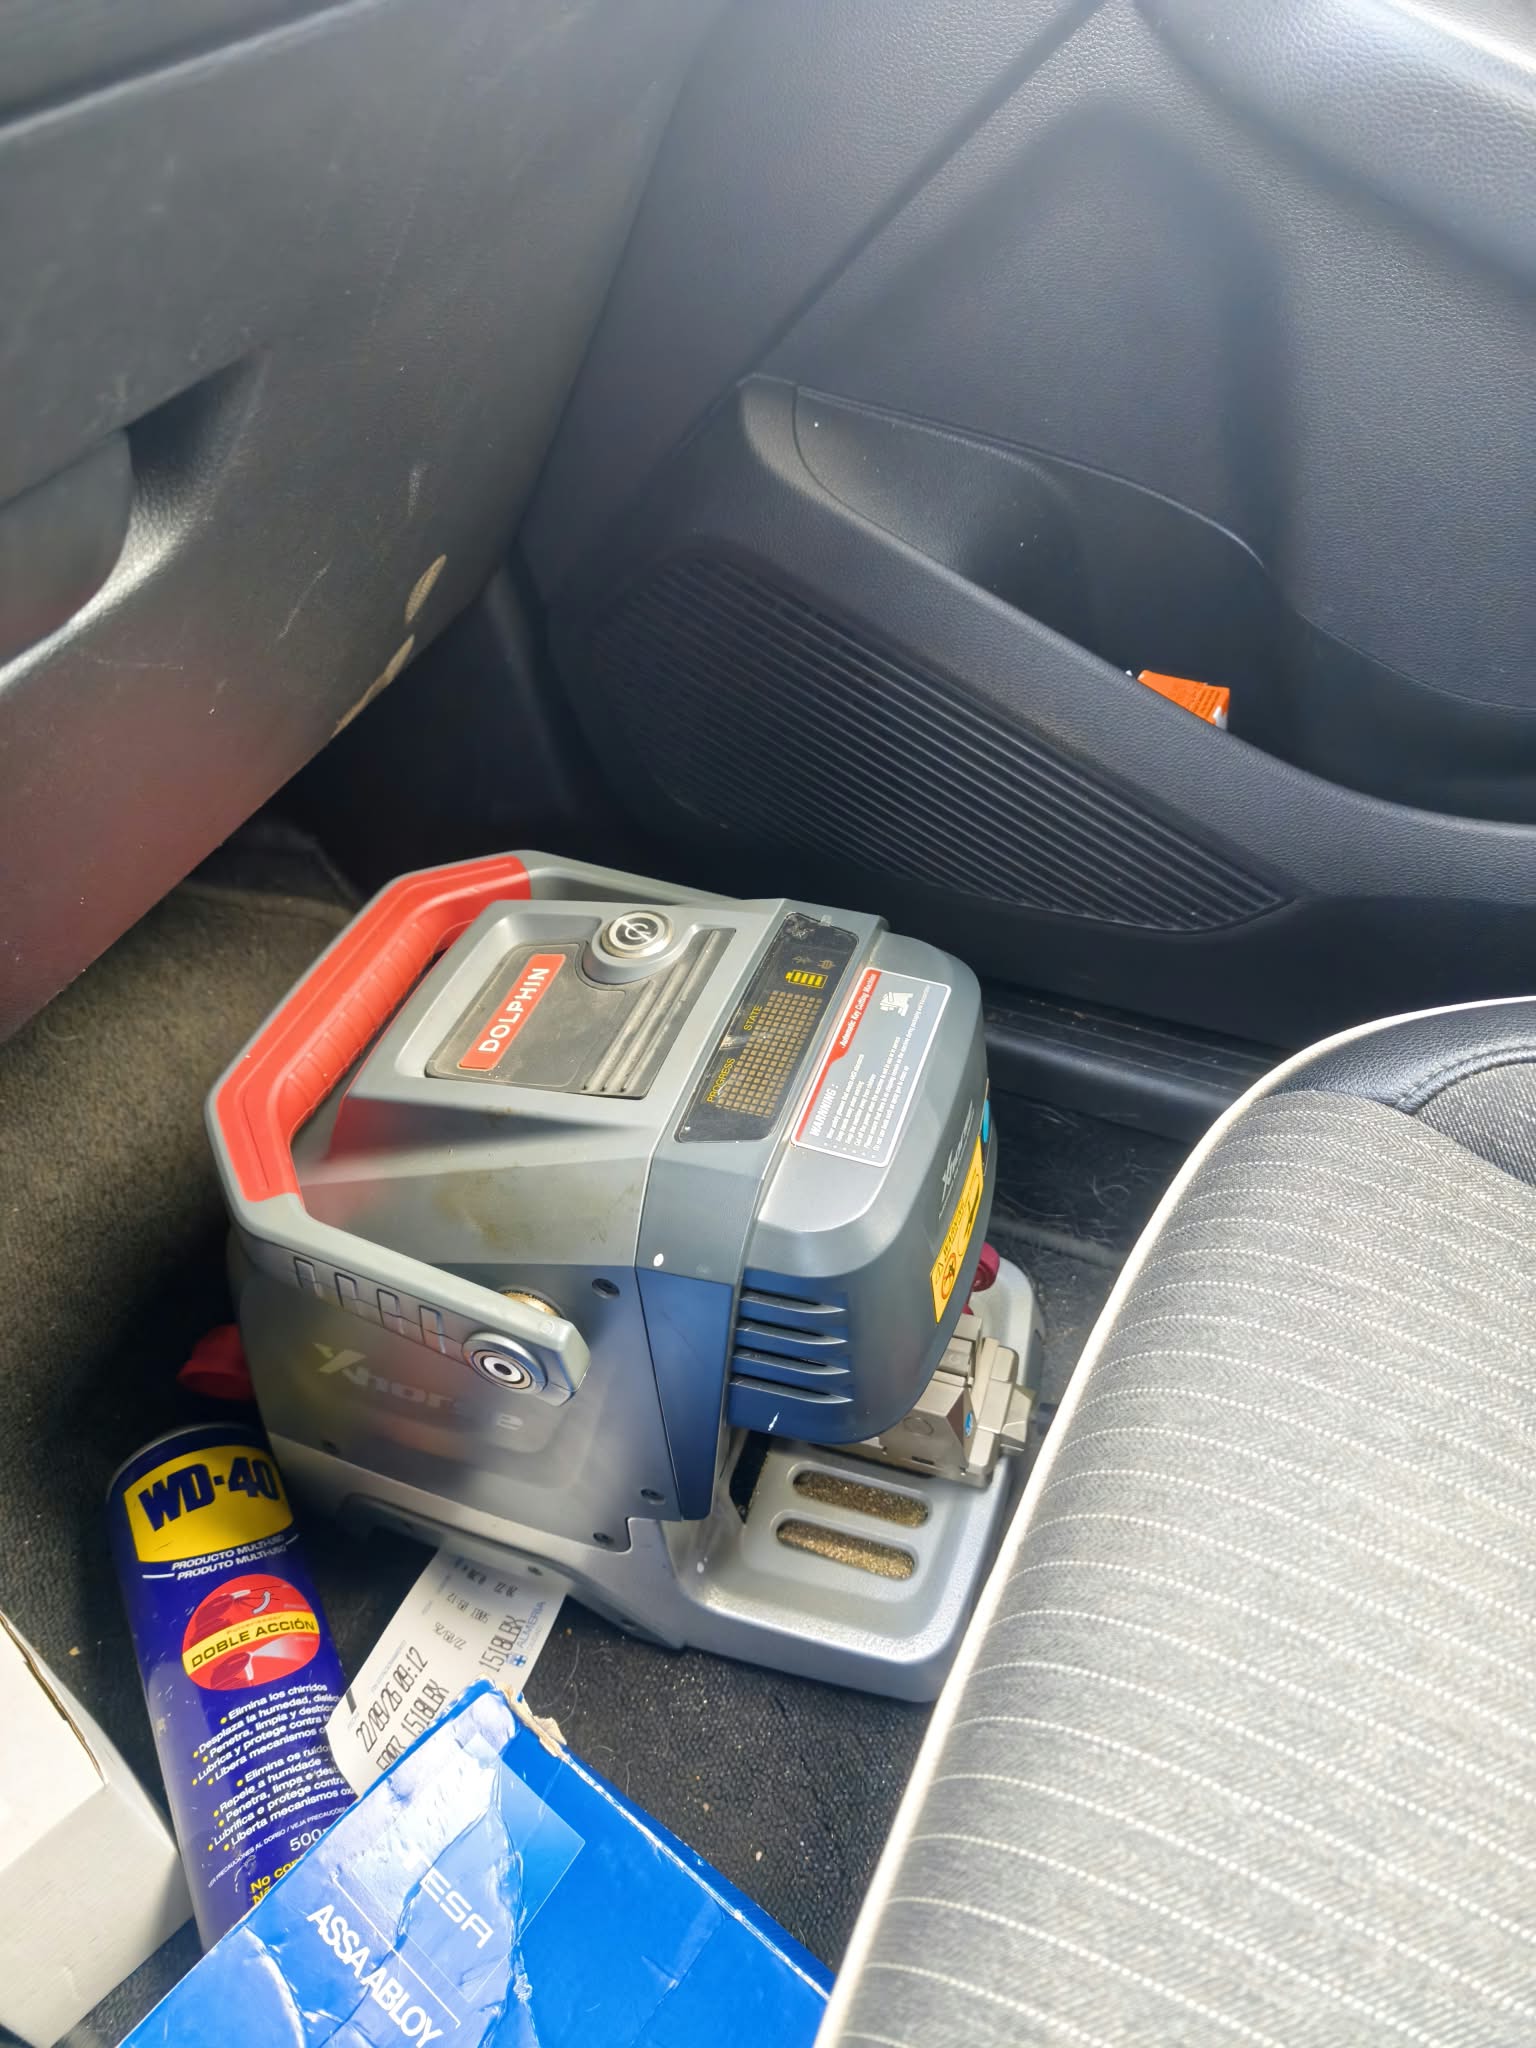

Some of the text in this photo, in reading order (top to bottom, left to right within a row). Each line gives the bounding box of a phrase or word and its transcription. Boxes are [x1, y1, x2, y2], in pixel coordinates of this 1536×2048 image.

[479, 967, 550, 1053] DOLPHIN
[743, 1005, 763, 1031] STATE
[707, 1057, 736, 1103] PROGRESS
[138, 1457, 281, 1531] WD-40
[172, 1550, 235, 1571] PRODUCTO
[177, 1560, 234, 1581] PRODUTO
[191, 1629, 251, 1668] DOBLE
[255, 1616, 315, 1638] ACCIÓN
[477, 1614, 526, 1672] 1518LBX
[197, 1718, 244, 1754] Desplaza
[244, 1712, 257, 1723] la
[257, 1695, 312, 1717] humedad,
[226, 1683, 328, 1720] Elimina los chirridos
[356, 1682, 402, 1752] 22/09/26
[391, 1645, 428, 1693] 09:12
[400, 1678, 449, 1737] 1518LBX
[196, 1750, 233, 1781] Lubrica
[233, 1745, 242, 1756] y
[241, 1724, 288, 1750] protege
[288, 1716, 322, 1730] contra
[207, 1726, 254, 1758] Penetra,
[254, 1711, 288, 1731] limpia
[289, 1709, 297, 1719] y
[213, 1727, 318, 1781] Libera mecanismos
[218, 1784, 256, 1813] Repele
[255, 1778, 266, 1788] a
[266, 1757, 322, 1783] humidade
[244, 1757, 285, 1782] Elimina
[285, 1751, 302, 1763] os
[213, 1809, 255, 1845] Lubrifica
[255, 1805, 265, 1815] e
[264, 1783, 312, 1810] protege
[224, 1788, 271, 1821] Penetra,
[271, 1773, 304, 1793] limpa
[304, 1771, 314, 1780] e
[229, 1789, 339, 1846] Liberta mecanismos
[250, 1875, 271, 1892] No
[307, 1904, 444, 2048] ASSA ABLOY
